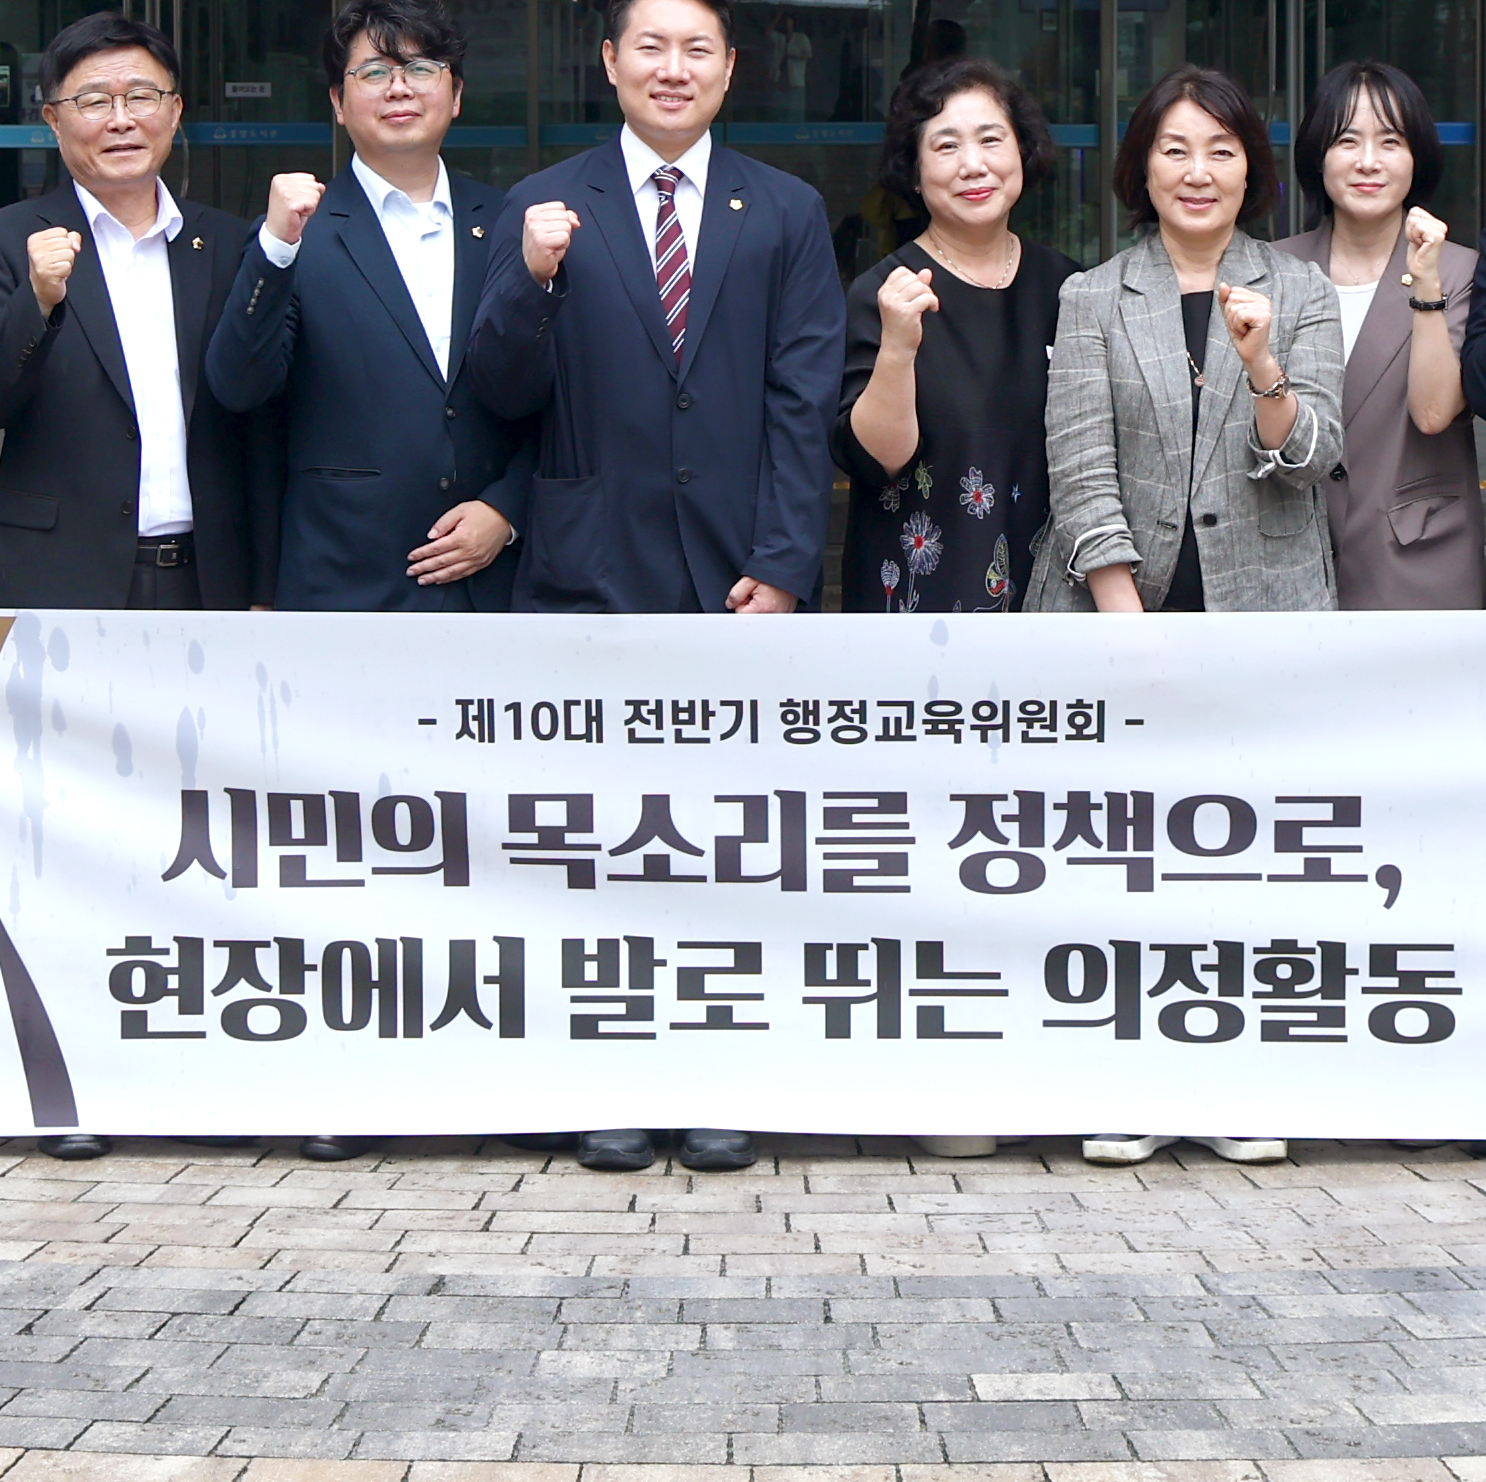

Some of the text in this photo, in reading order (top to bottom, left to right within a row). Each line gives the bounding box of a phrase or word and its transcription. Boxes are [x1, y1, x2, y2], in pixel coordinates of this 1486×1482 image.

[455, 699, 603, 743] 제10대
[624, 699, 758, 744] 전반기
[779, 698, 1105, 744] 행정교육위원회
[161, 787, 1402, 909] 시민의 목소리를 정책으로,
[106, 935, 1462, 1044] 현장에서 발로 뛰는 의정활동
